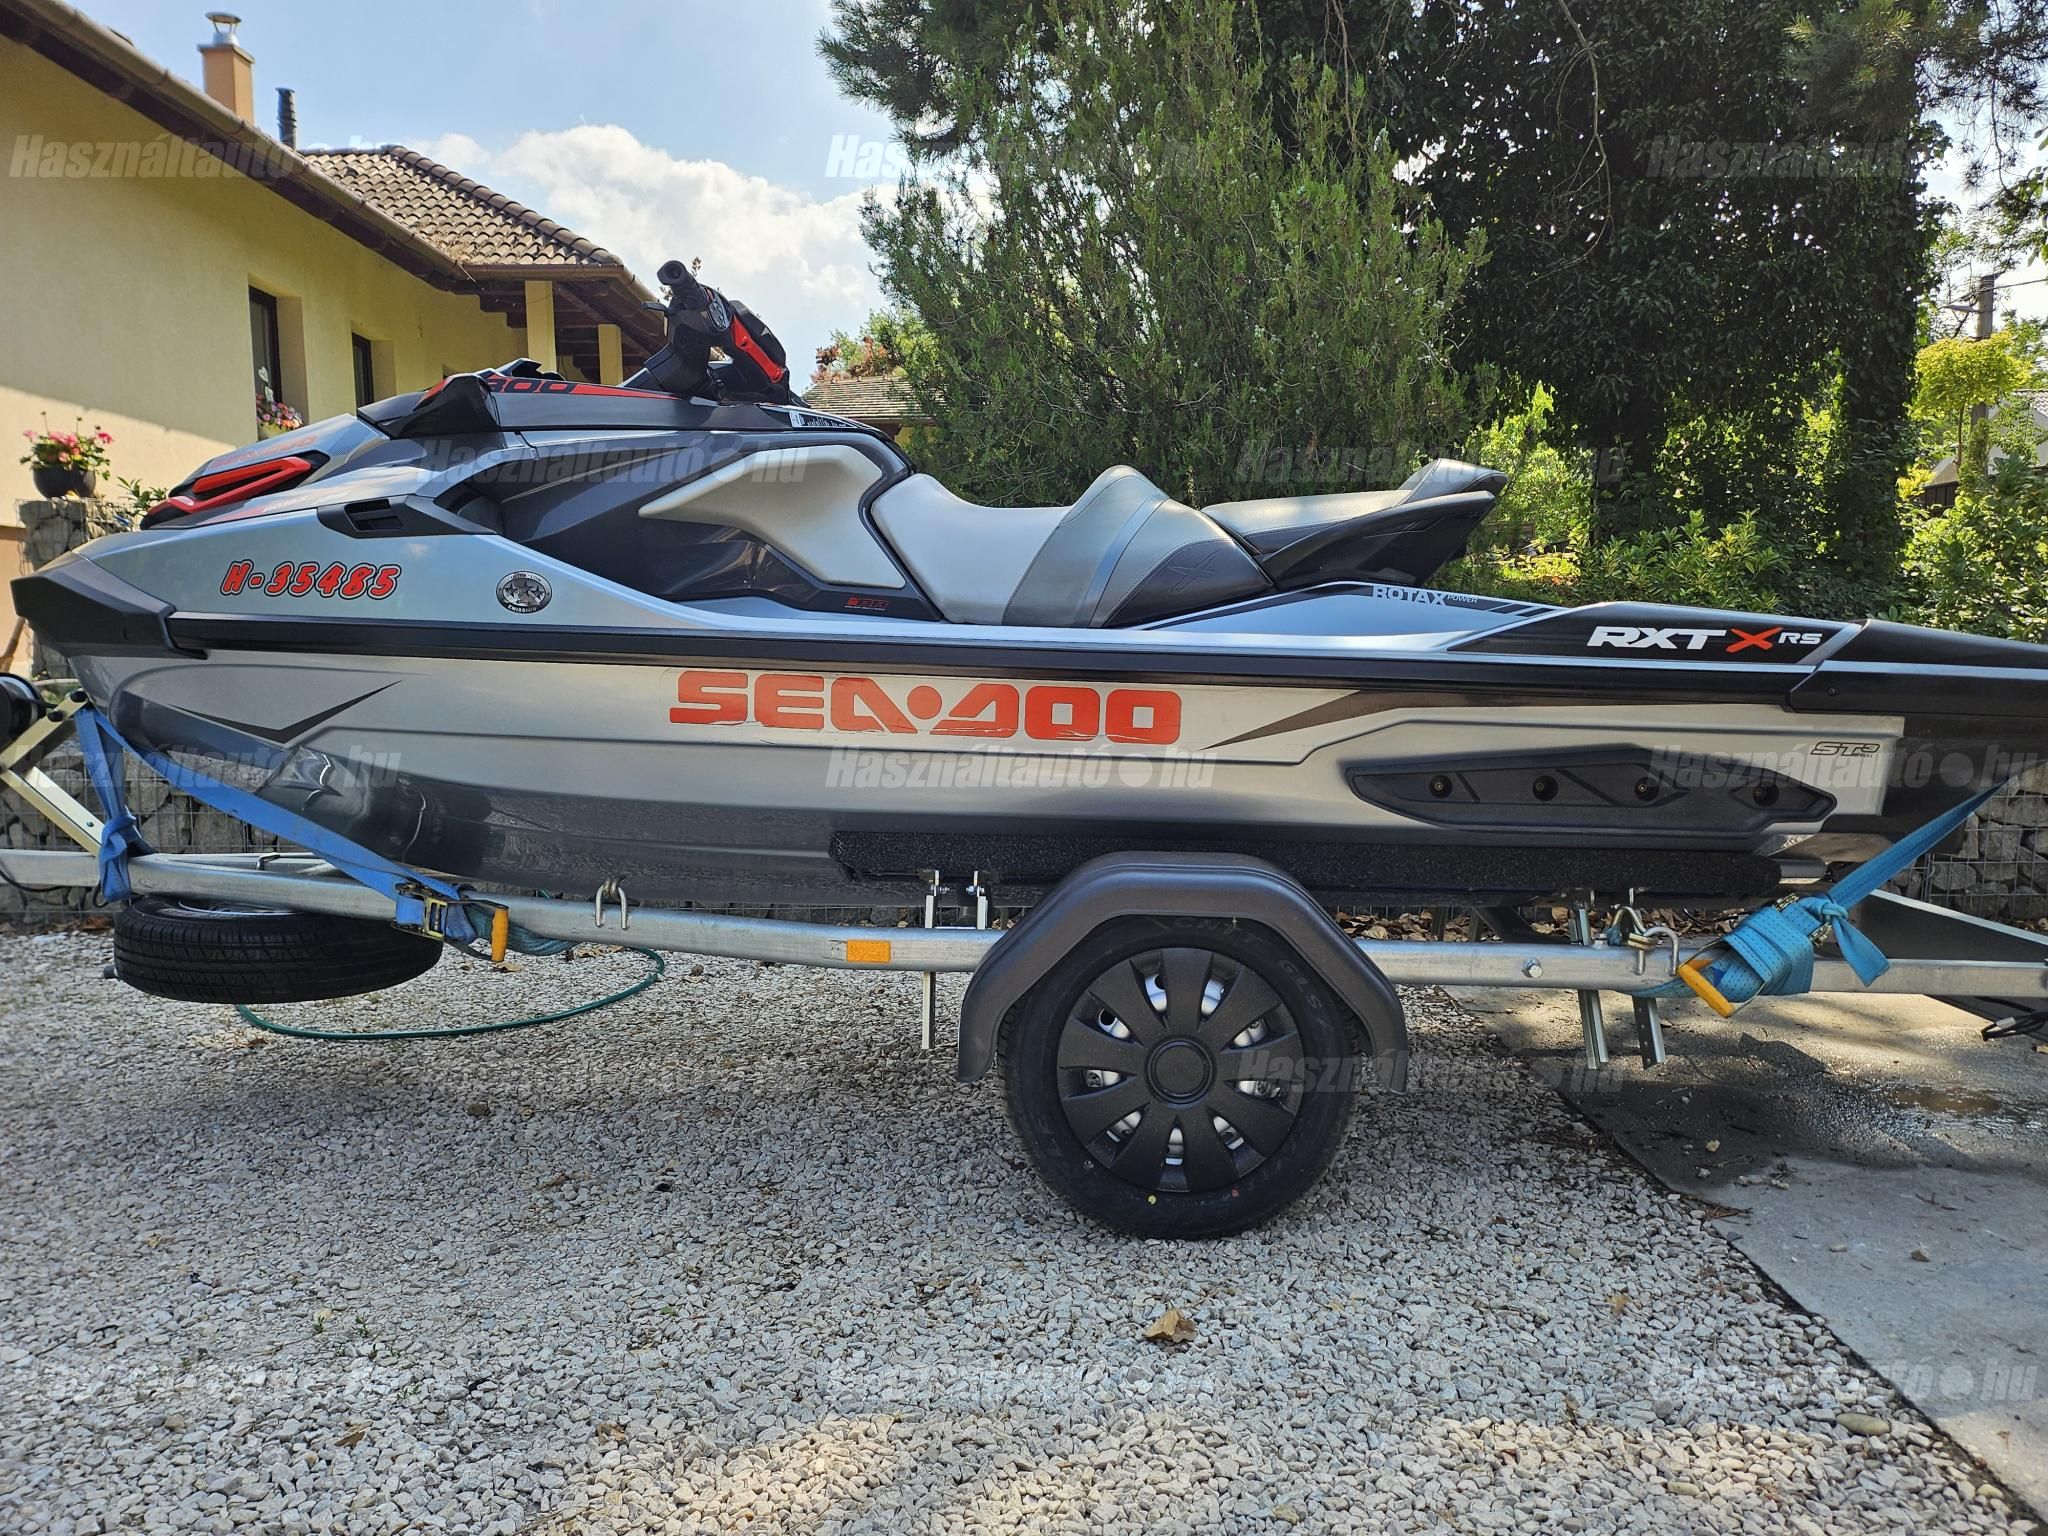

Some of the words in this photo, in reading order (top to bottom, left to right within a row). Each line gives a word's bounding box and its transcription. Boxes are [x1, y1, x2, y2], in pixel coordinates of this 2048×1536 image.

[220, 558, 402, 601] H-35485
[1372, 586, 1447, 607] ROTAX
[1447, 594, 1478, 604] POWER
[1587, 626, 1727, 650] RXT
[1726, 626, 1784, 653] X
[1778, 632, 1822, 645] RS
